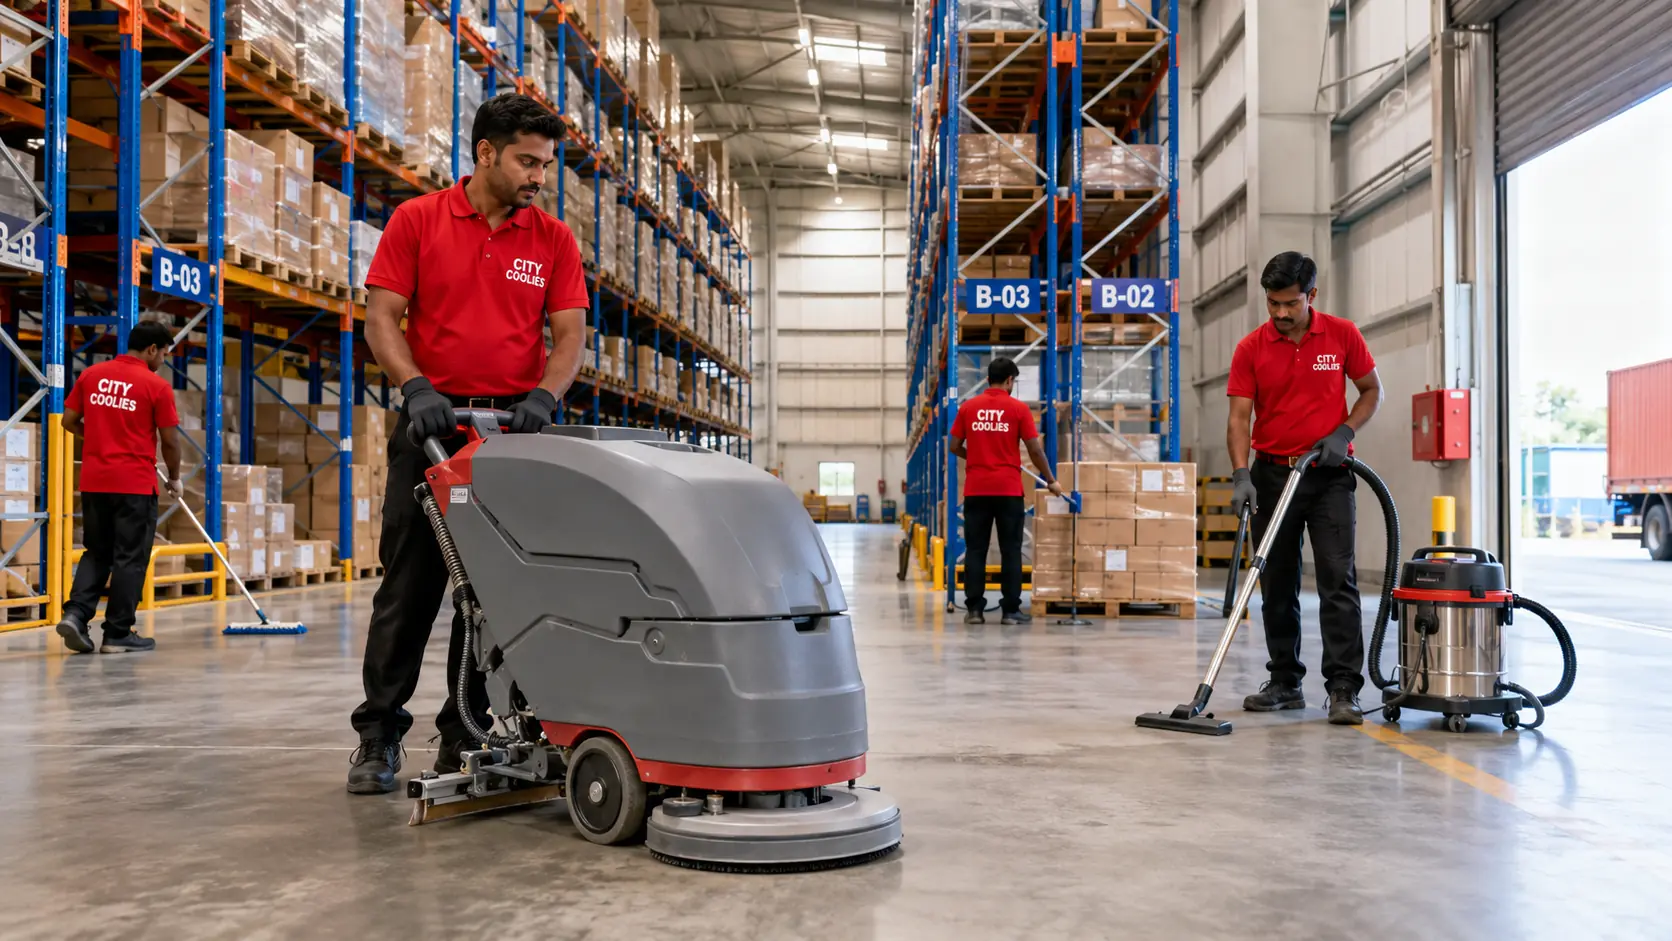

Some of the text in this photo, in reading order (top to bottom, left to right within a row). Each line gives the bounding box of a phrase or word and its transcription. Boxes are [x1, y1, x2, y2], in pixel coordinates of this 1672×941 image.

[160, 256, 201, 296] B-03
[513, 258, 543, 276] CITY
[505, 269, 546, 288] COOLIES
[976, 284, 1030, 309] B-03
[1101, 284, 1155, 309] B-02
[1316, 354, 1337, 363] CITY
[97, 378, 133, 397] CITY
[89, 392, 137, 412] COOLIES
[977, 409, 1005, 422] CITY
[971, 421, 1010, 433] COOLIES
